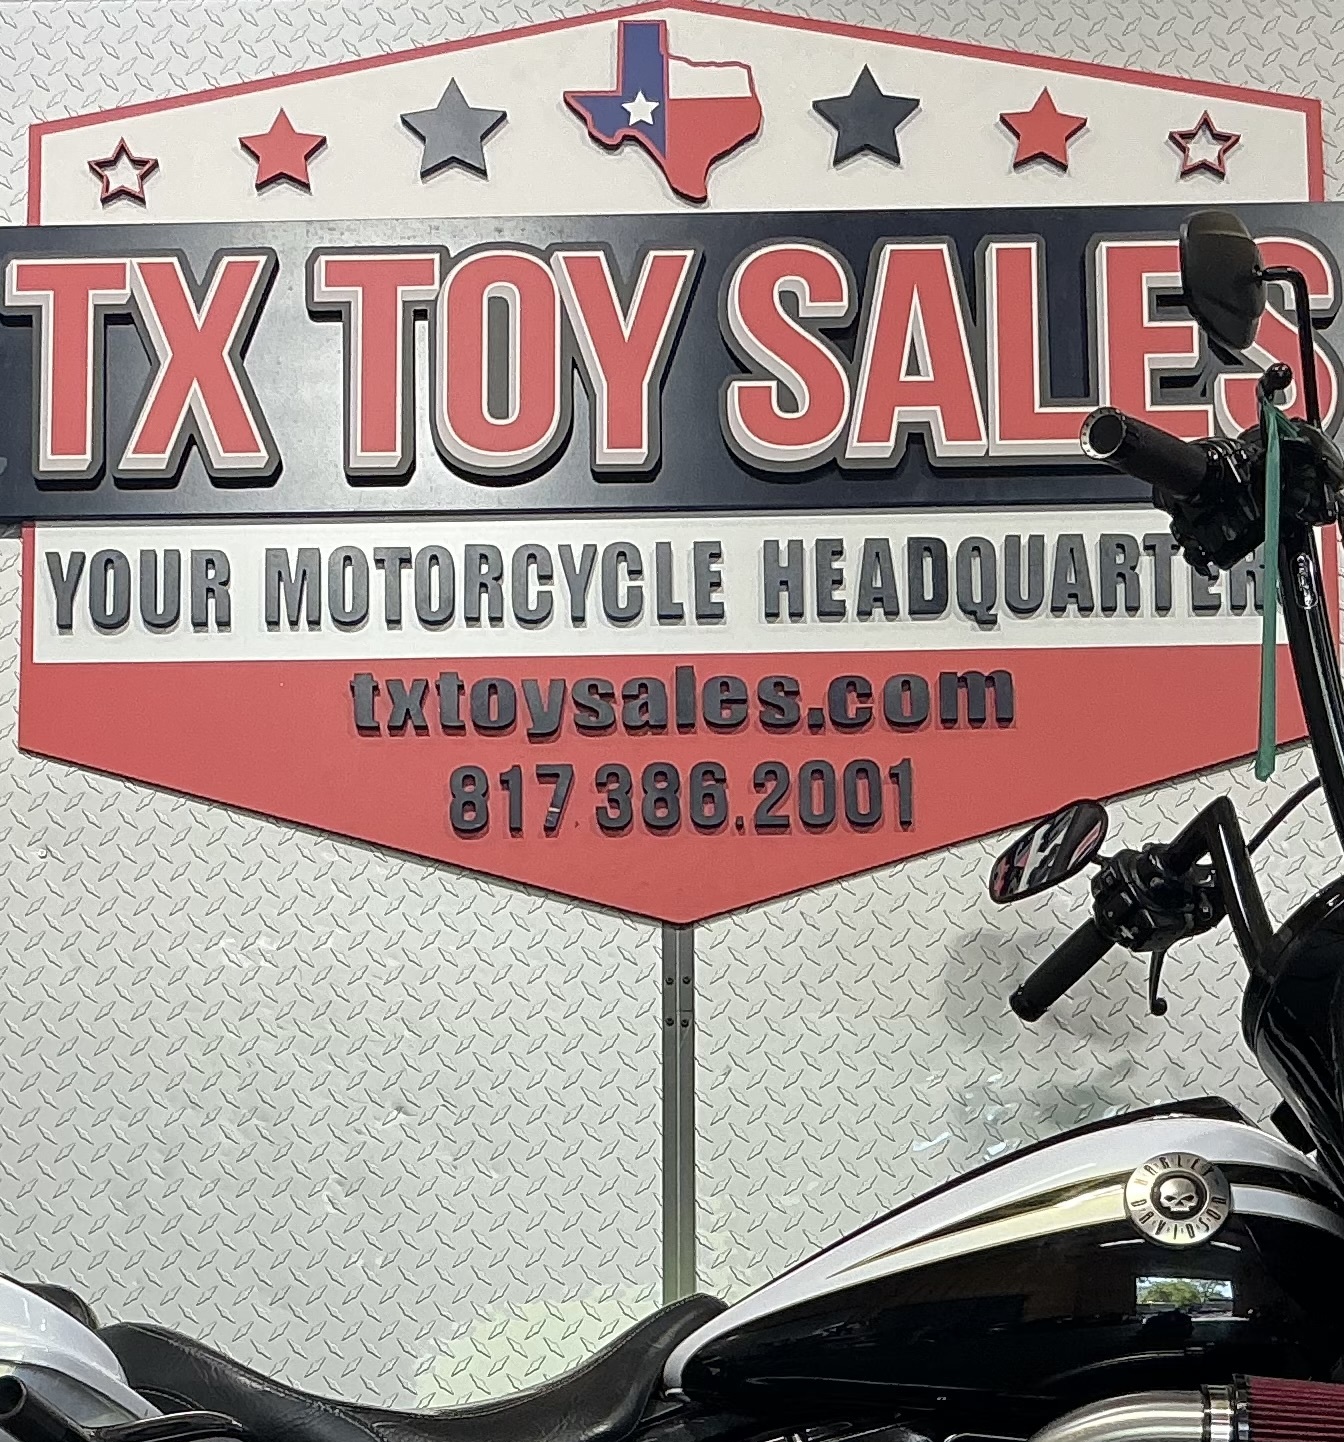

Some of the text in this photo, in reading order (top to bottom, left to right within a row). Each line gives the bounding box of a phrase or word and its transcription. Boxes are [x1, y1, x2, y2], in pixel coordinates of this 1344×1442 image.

[2, 237, 1342, 482] TX TOY SALES
[47, 549, 232, 631] YOUR
[264, 540, 724, 630] MOTORCYCLE
[350, 665, 1015, 741] txtoysales.com
[449, 763, 574, 836] 817
